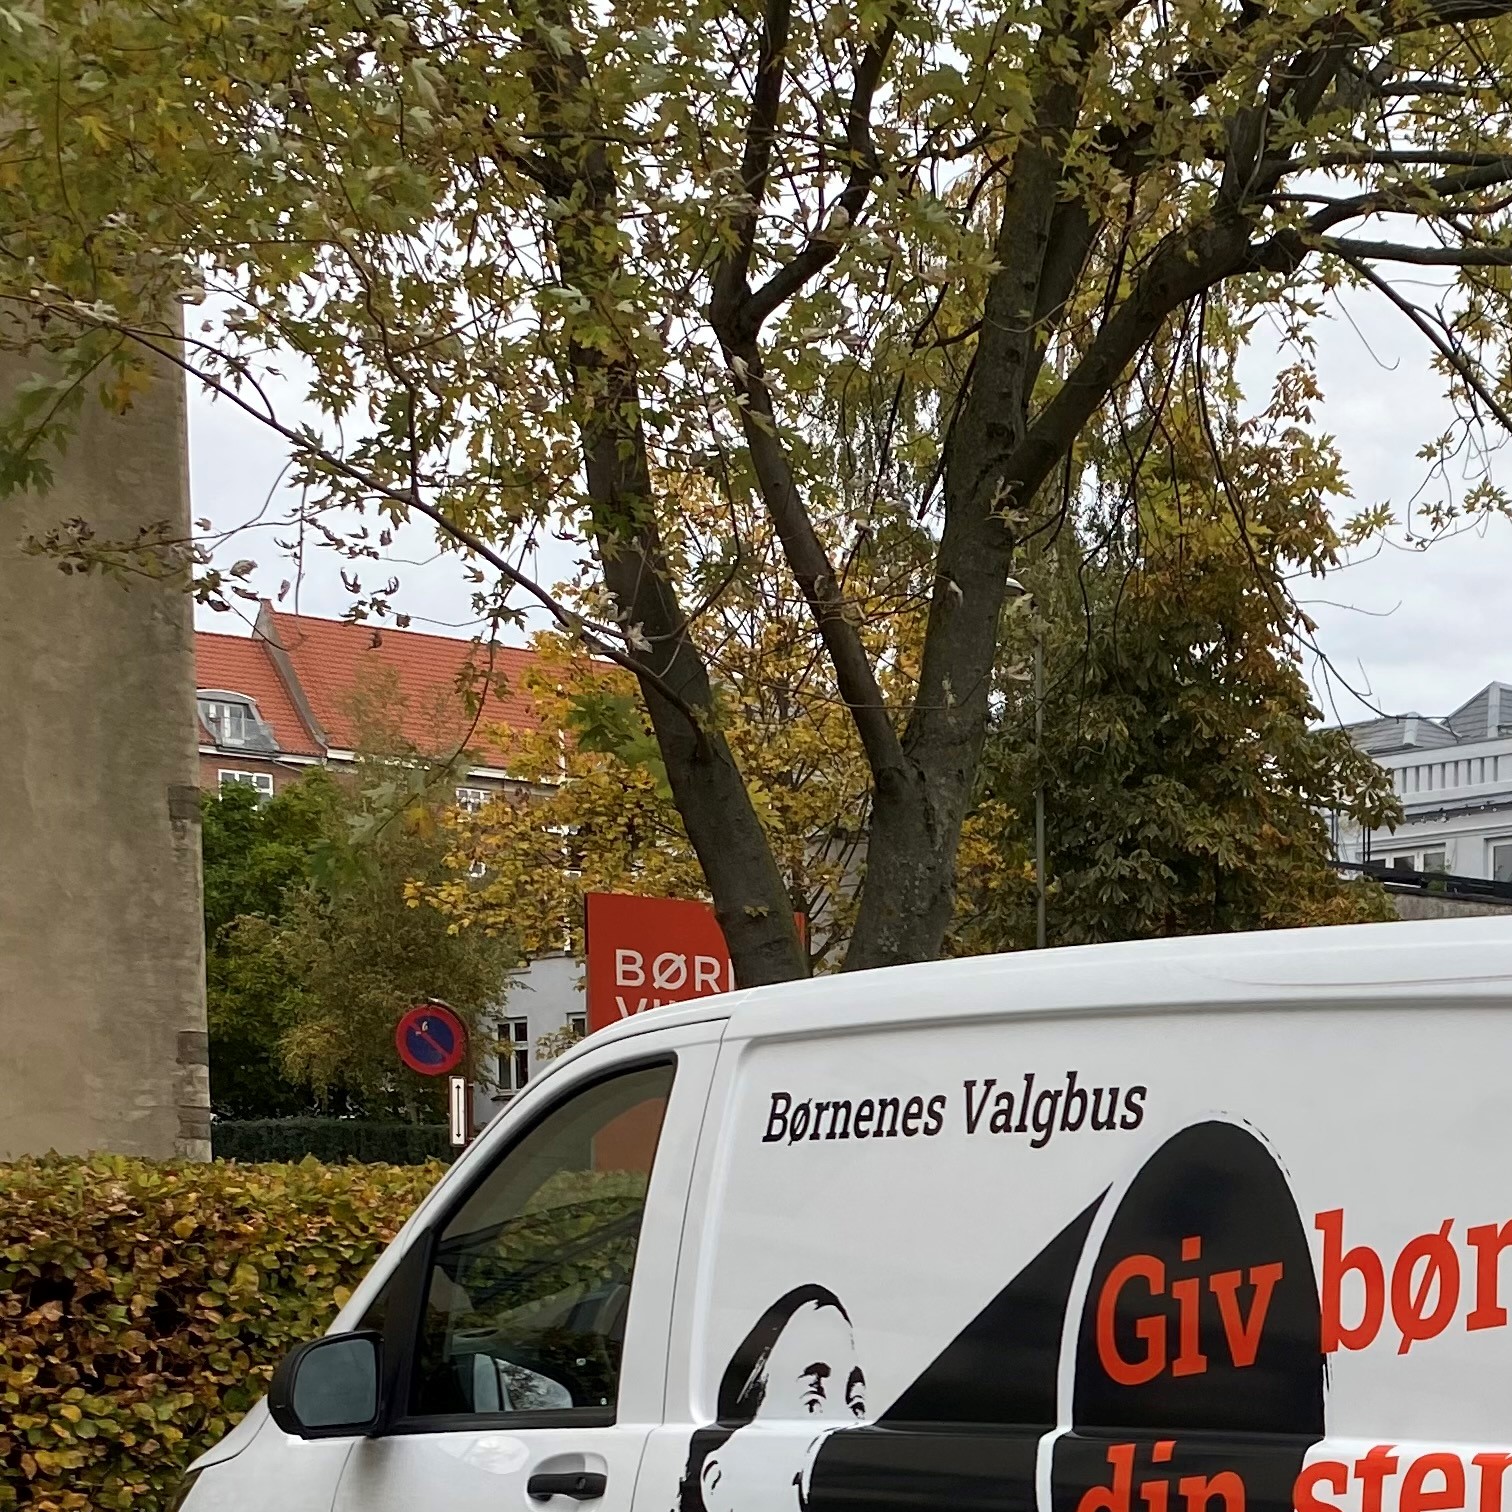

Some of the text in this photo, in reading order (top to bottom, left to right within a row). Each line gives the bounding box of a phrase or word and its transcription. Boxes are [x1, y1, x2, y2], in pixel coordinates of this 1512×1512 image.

[615, 948, 735, 993] BØR
[762, 1071, 1148, 1149] Børnenes Valgbus
[1096, 1236, 1283, 1386] Giv
